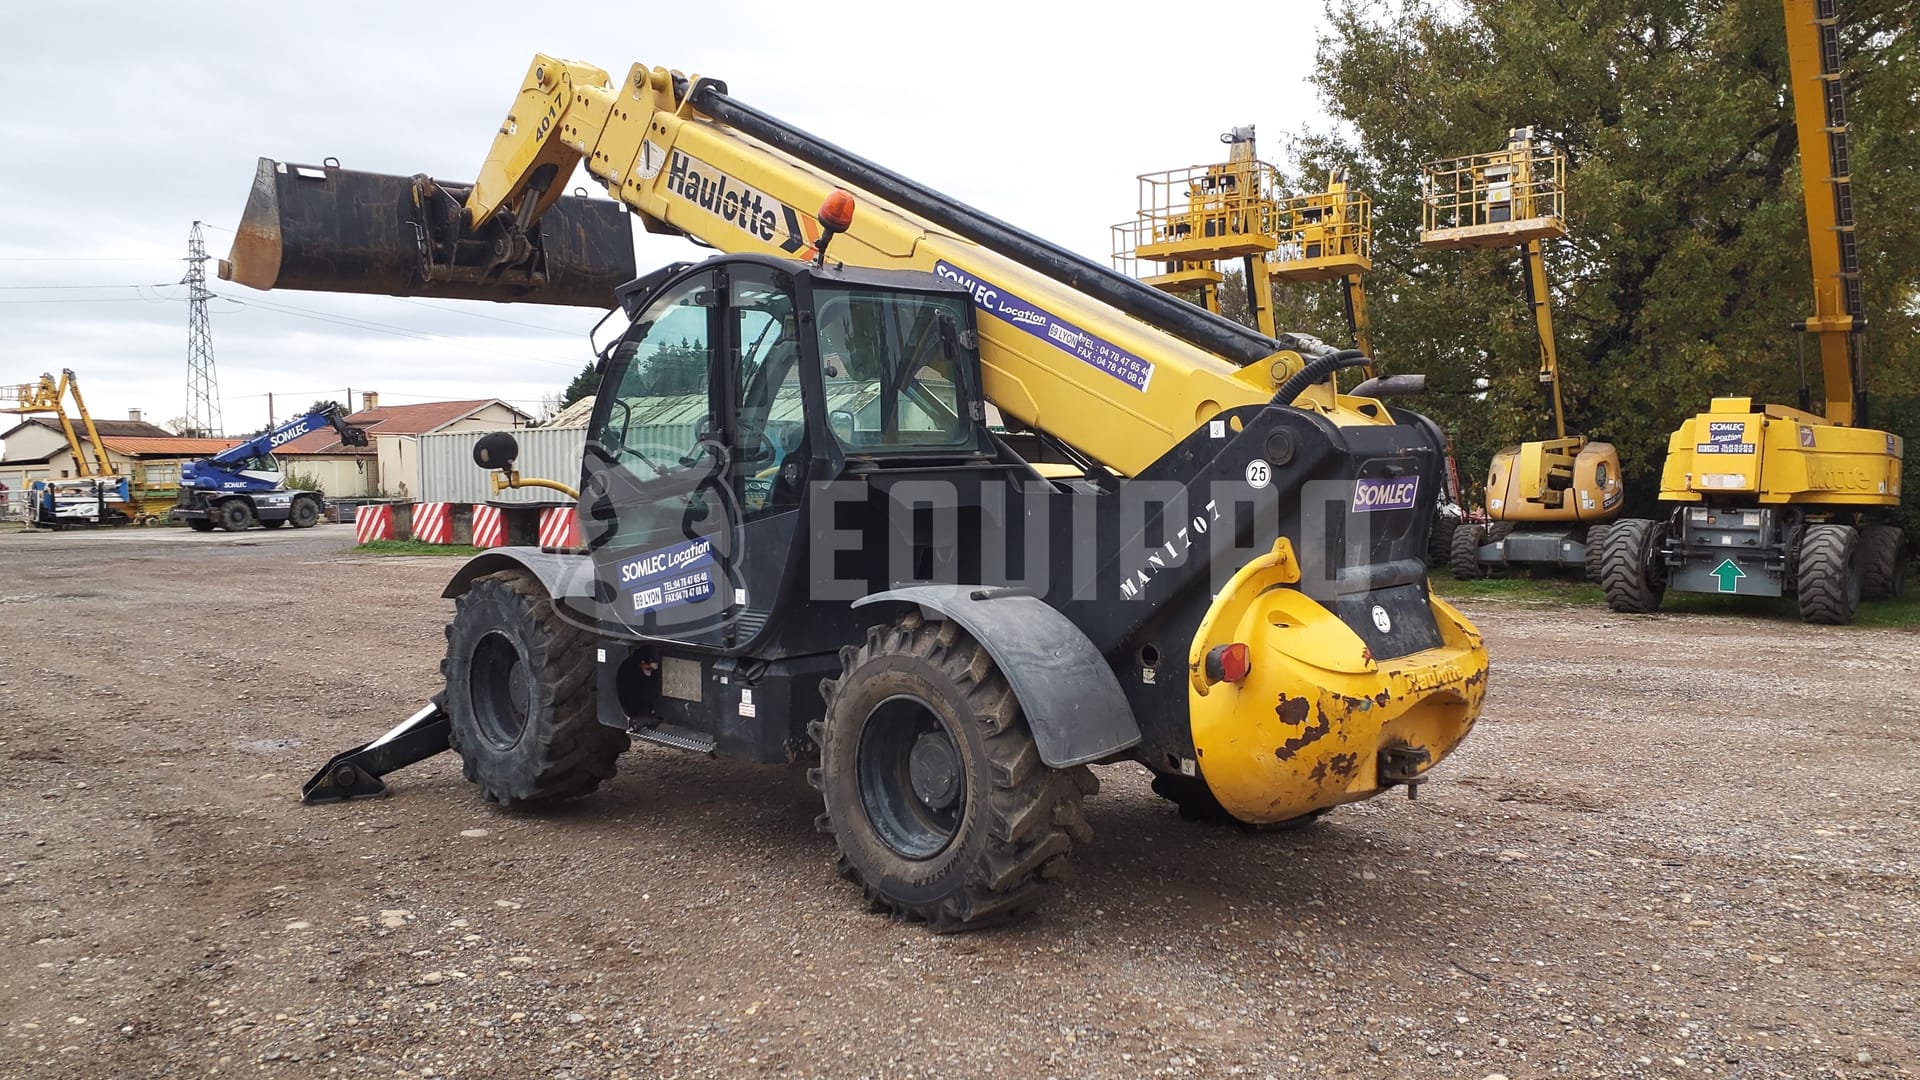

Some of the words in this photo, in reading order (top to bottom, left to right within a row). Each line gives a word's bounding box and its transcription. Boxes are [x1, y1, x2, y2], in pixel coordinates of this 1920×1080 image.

[536, 92, 562, 143] 4017
[667, 152, 776, 241] Haulotte
[999, 301, 1046, 325] Location
[1058, 330, 1077, 346] LYON
[1077, 346, 1092, 360] FAX
[1096, 356, 1106, 366] 04
[1107, 361, 1116, 372] 78
[1117, 366, 1127, 376] 47
[1127, 371, 1137, 382] 08
[1100, 346, 1109, 357] 04
[1111, 351, 1120, 362] 78
[1120, 356, 1130, 366] 47
[1130, 361, 1140, 372] 65
[271, 422, 309, 448] SOMLEC
[1711, 423, 1744, 431] SOMLEC
[1251, 466, 1266, 482] 25
[1356, 483, 1414, 505] SOMLEC
[622, 554, 666, 582] SOMLEC
[668, 541, 710, 567] Location
[644, 590, 660, 606] LYON
